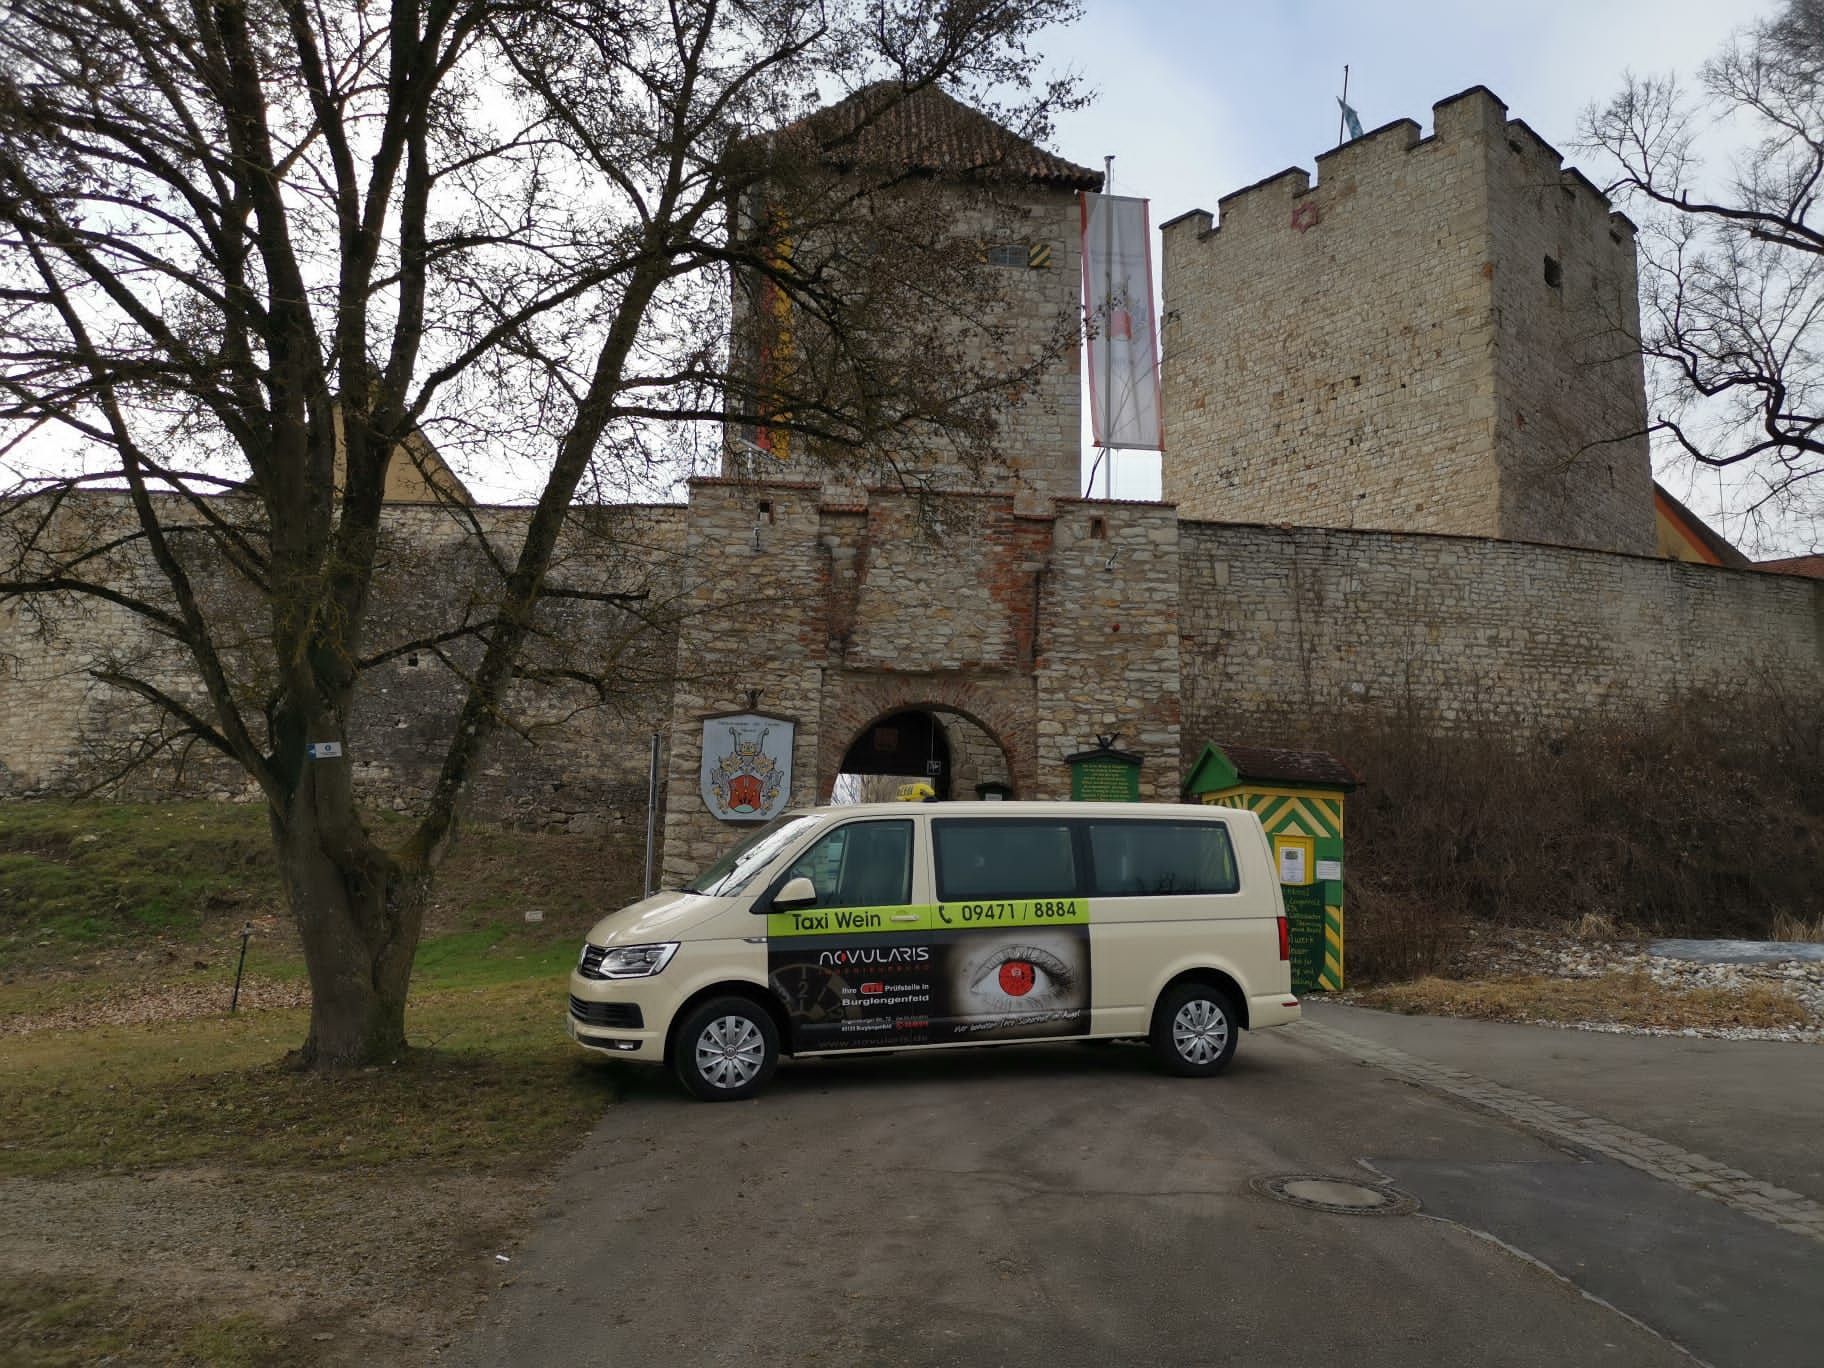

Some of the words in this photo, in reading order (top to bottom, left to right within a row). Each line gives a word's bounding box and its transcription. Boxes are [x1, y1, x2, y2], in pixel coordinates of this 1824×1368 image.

[792, 913, 829, 930] Taxi
[834, 911, 881, 928] Wein
[962, 904, 1014, 921] 09471
[1034, 901, 1076, 918] 8884
[819, 946, 929, 966] NOVULARIS
[884, 983, 920, 992] Prüfstelle
[842, 994, 929, 1007] Burglengenfeld
